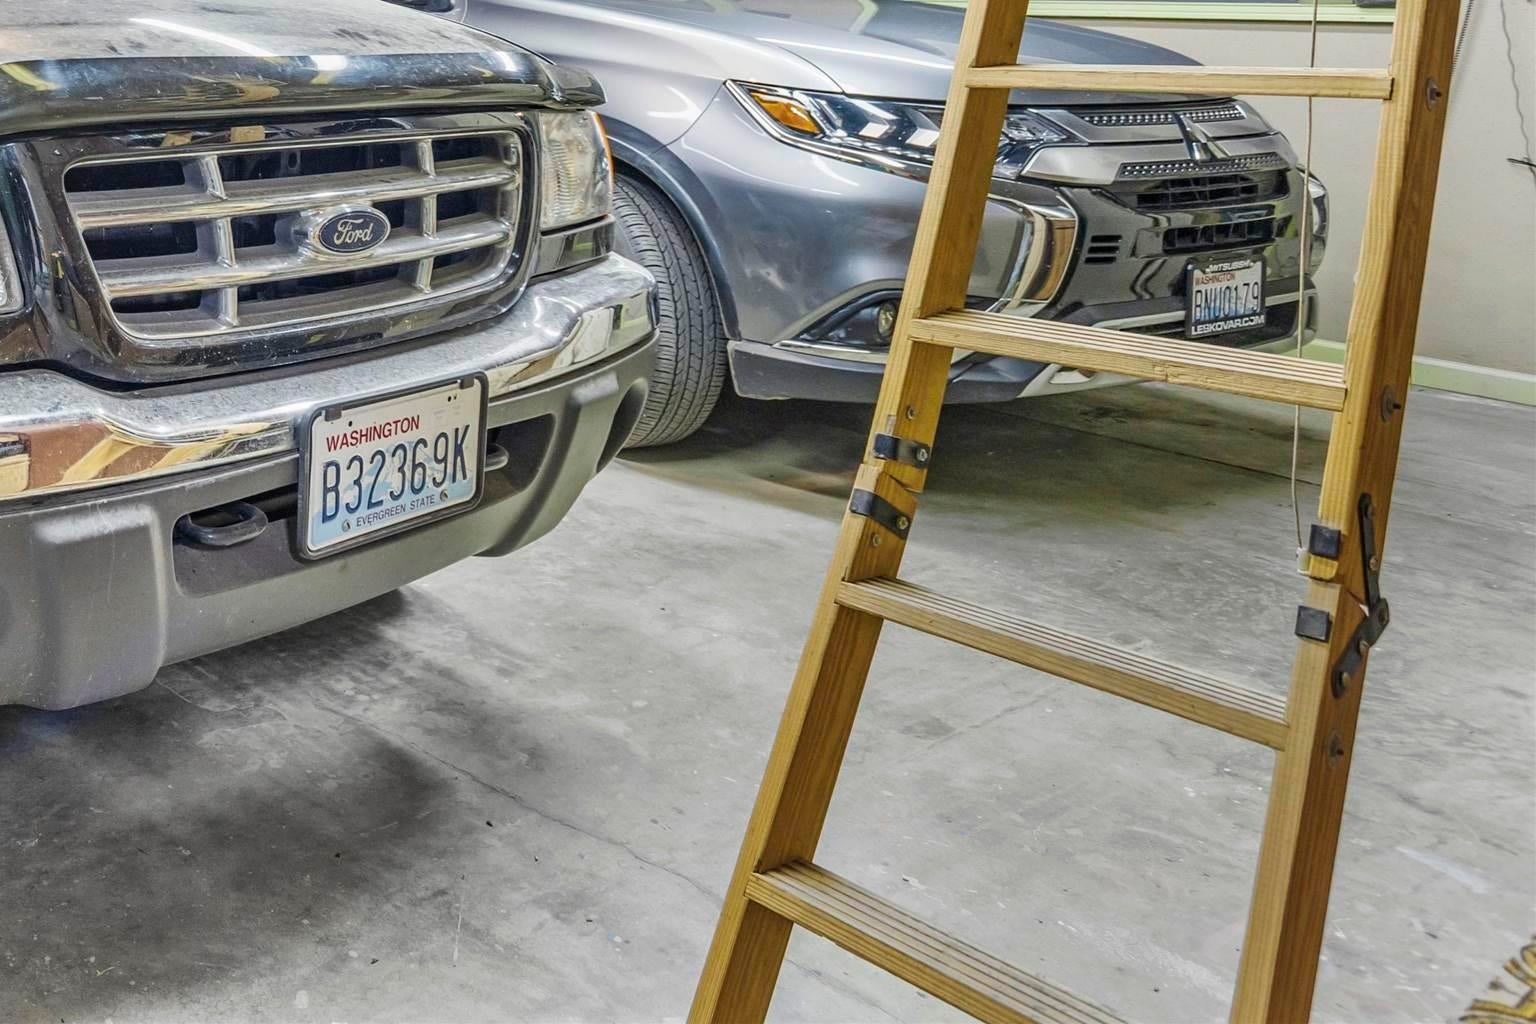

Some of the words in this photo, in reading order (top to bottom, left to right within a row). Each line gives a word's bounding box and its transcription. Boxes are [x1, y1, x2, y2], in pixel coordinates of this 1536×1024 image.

[333, 218, 374, 246] Ford
[1195, 272, 1236, 285] WASHINGTON
[1191, 314, 1265, 336] LESKOVAR.COM
[326, 414, 421, 453] WASHINGTON
[321, 424, 471, 525] B32369K
[356, 504, 407, 528] EVERGREEN
[409, 494, 436, 512] STATE
